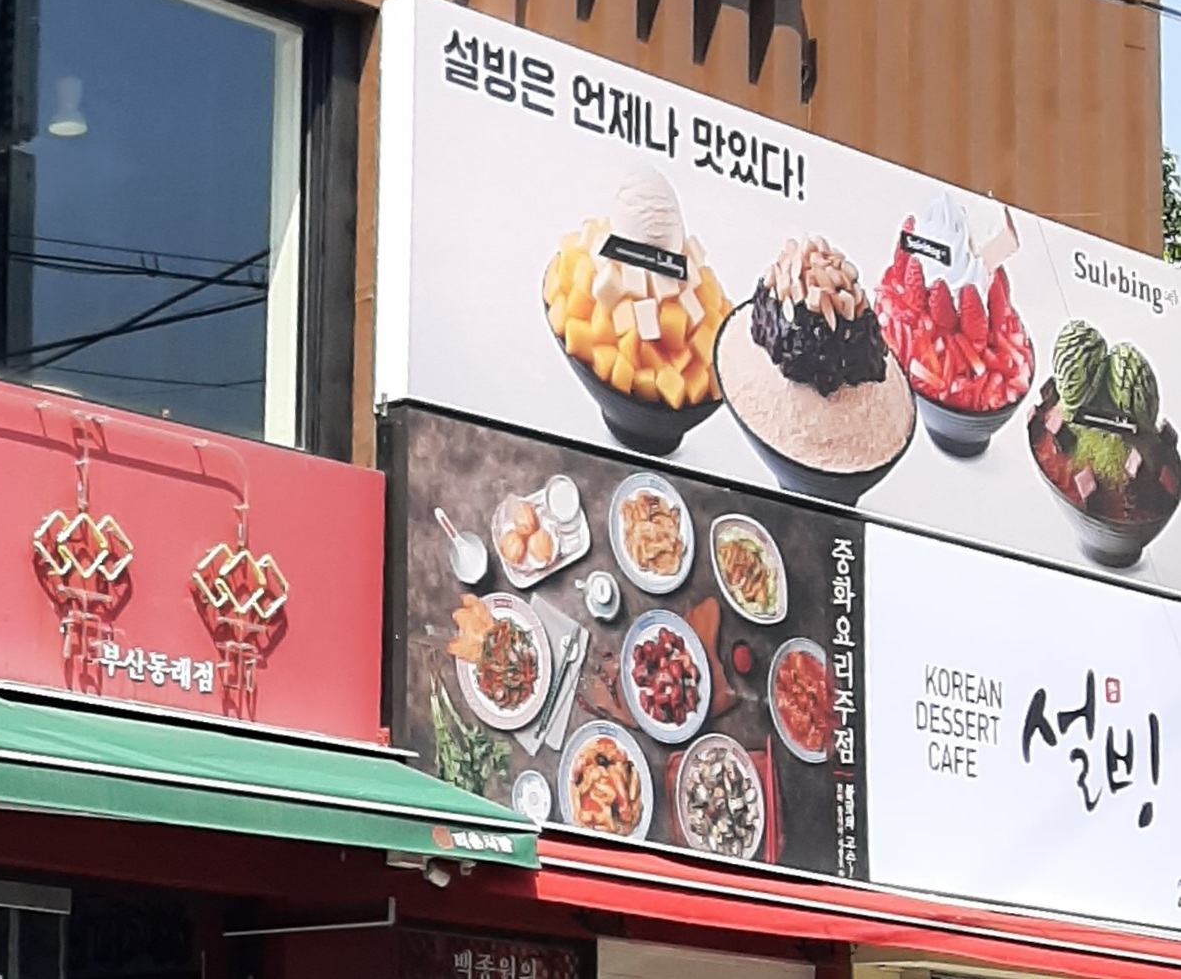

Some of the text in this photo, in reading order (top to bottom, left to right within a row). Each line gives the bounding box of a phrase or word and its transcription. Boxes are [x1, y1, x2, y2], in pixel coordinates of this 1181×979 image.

[443, 28, 808, 200] 설빙은 언제나 맛있다!
[99, 642, 214, 693] 부산동래점
[924, 664, 1003, 710] KOREAN
[916, 701, 1000, 746] DESSERT
[928, 742, 978, 779] CAFE
[1022, 669, 1160, 829] 설빙
